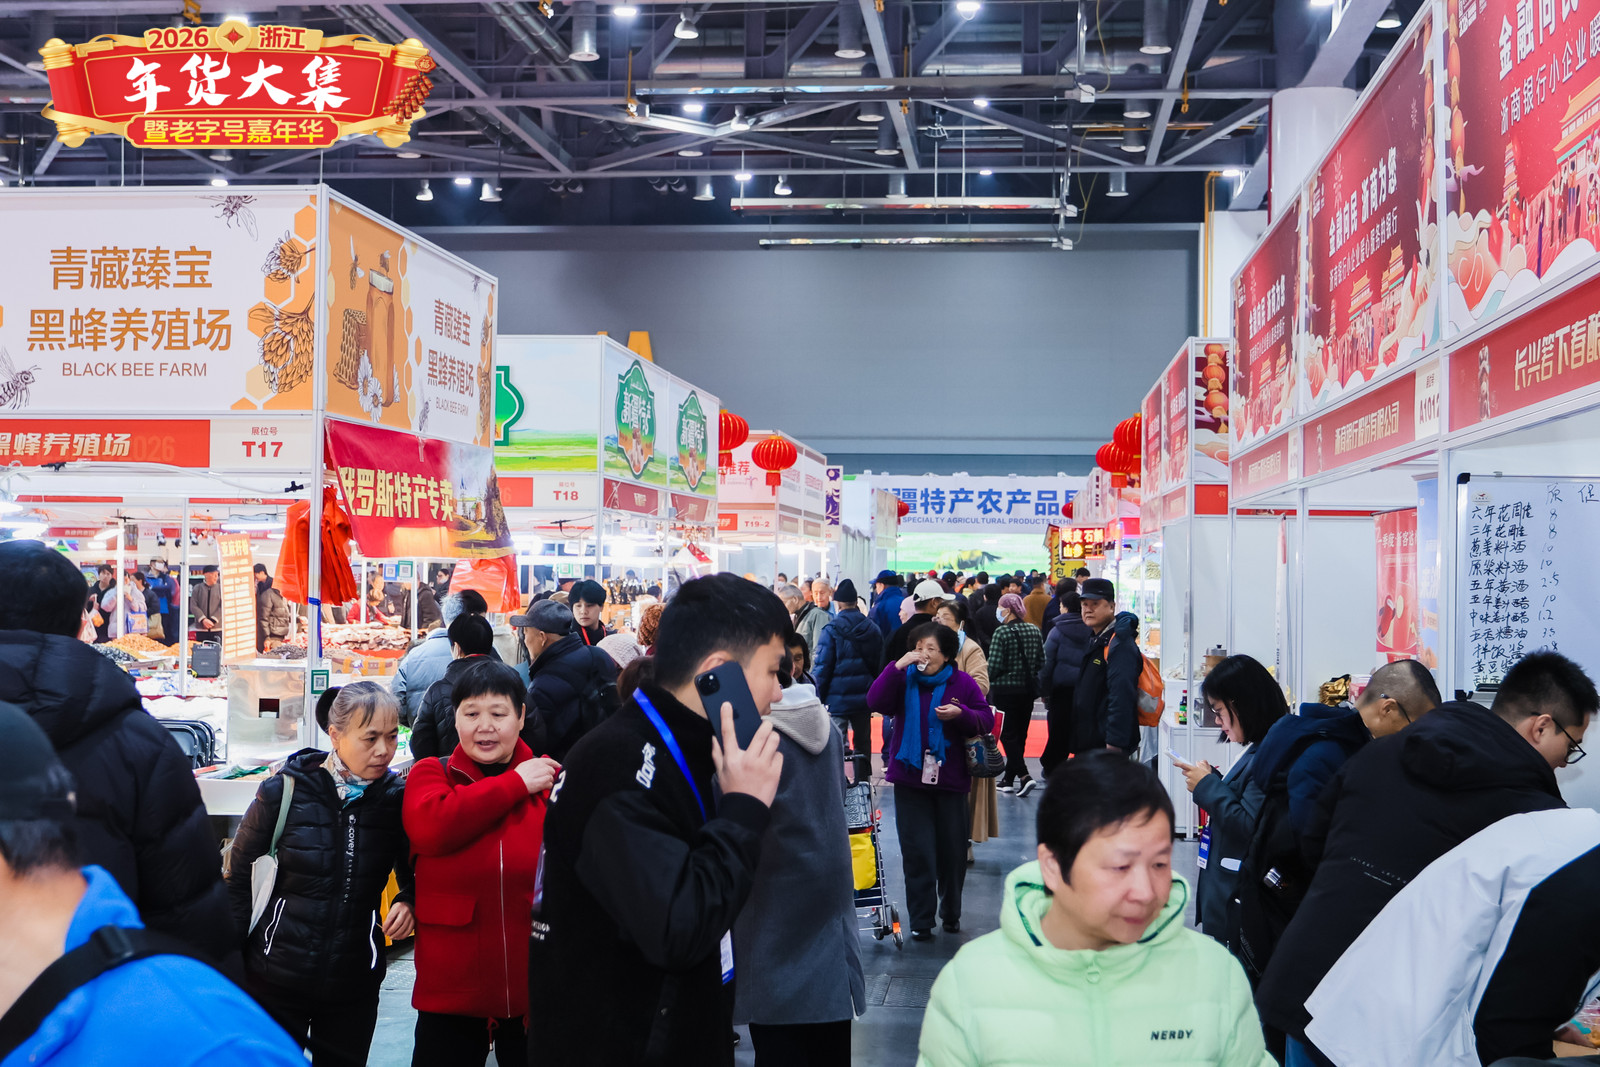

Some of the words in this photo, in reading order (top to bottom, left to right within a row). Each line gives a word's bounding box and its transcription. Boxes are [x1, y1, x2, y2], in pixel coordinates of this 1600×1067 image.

[50, 246, 212, 290] 青藏臻宝
[27, 307, 232, 352] 黑蜂养殖场
[434, 298, 471, 346] 青藏臻宝
[62, 362, 116, 376] BLACK
[122, 362, 154, 376] BEE
[160, 362, 207, 376] FARM
[428, 348, 474, 398] 黑蜂养殖场
[436, 397, 449, 412] BLACK
[450, 401, 458, 414] BEE
[458, 404, 468, 416] FARM
[251, 426, 278, 436] 展位号
[242, 441, 284, 458] T17
[338, 465, 454, 522] 俄罗斯特产专卖
[553, 490, 578, 500] T18
[883, 488, 1078, 516] 疆特产农产品
[1550, 508, 1558, 521] 8
[1549, 524, 1557, 540] 8
[1542, 543, 1554, 552] 10
[1540, 558, 1552, 570] 10
[1542, 572, 1560, 588] 2.5
[1542, 594, 1556, 608] 10
[1538, 610, 1554, 620] 1.2
[1150, 1030, 1194, 1040] NERDY
